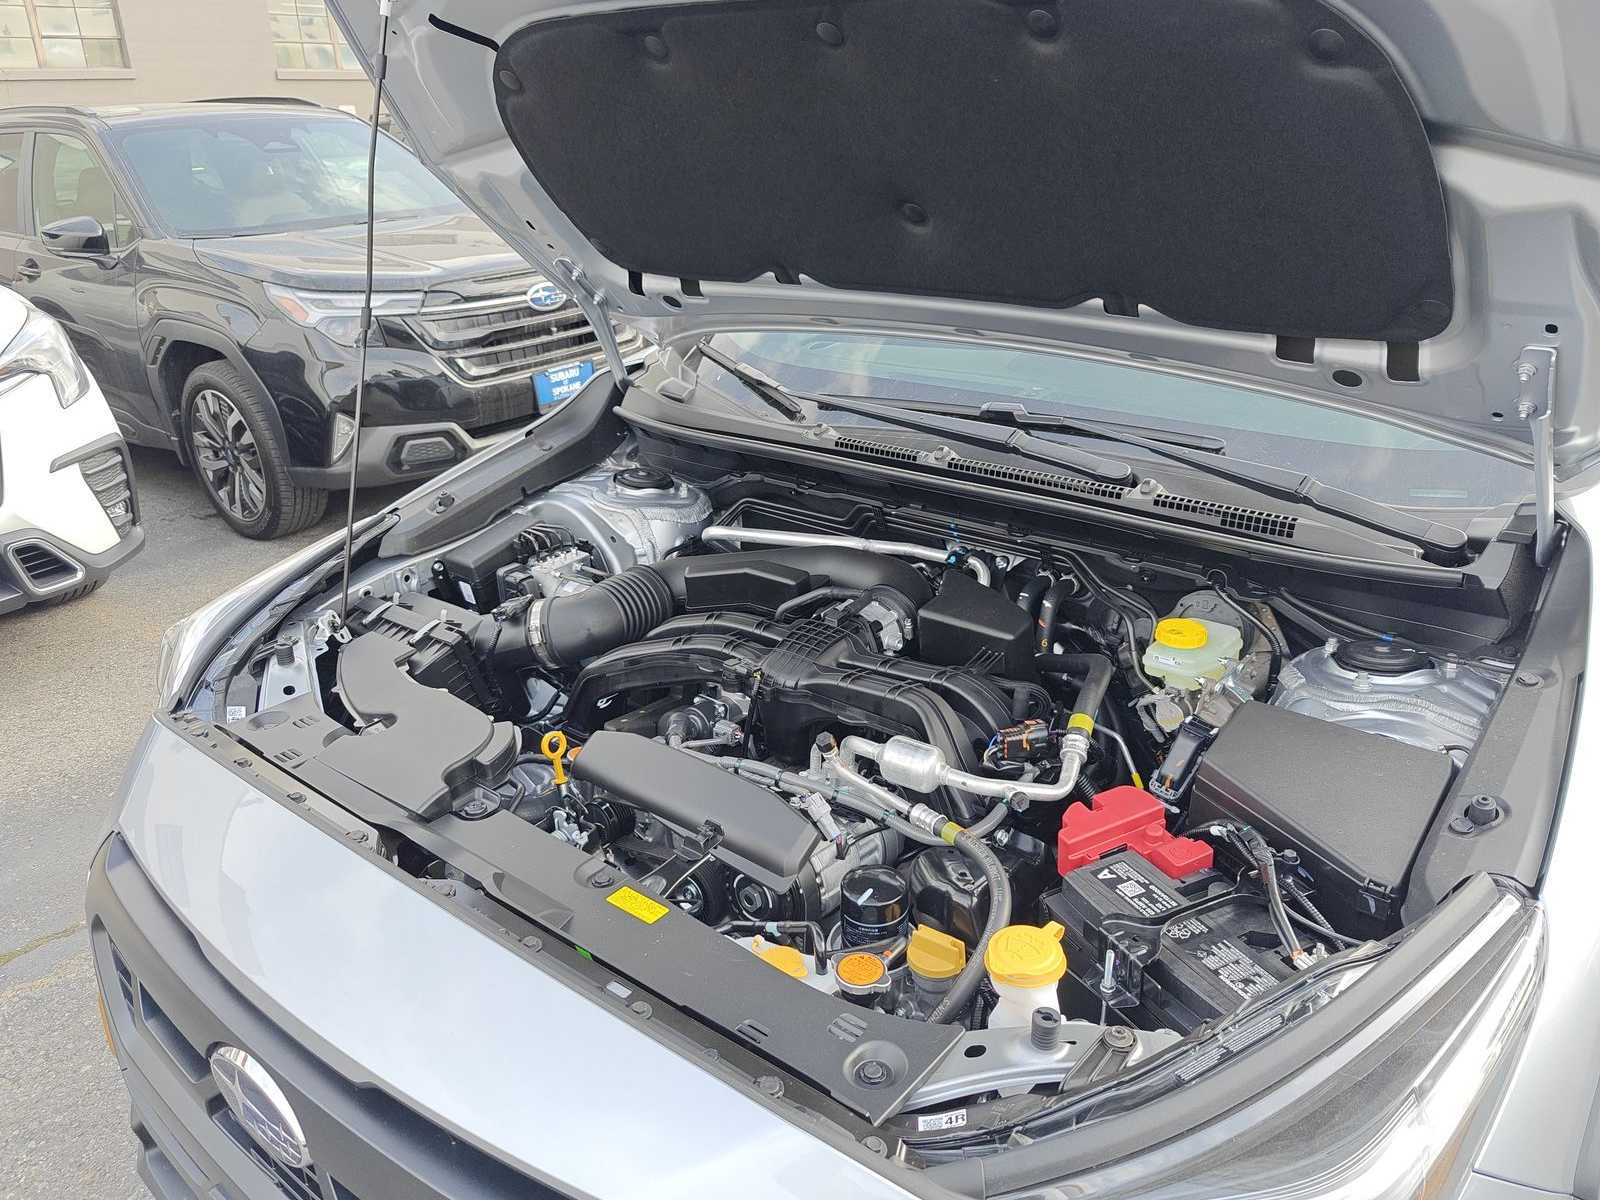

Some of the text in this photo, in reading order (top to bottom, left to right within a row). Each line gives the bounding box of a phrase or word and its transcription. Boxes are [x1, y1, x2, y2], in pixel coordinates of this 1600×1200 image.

[550, 367, 580, 383] SUBARU
[1097, 868, 1117, 880] A
[944, 1113, 966, 1125] 4R
